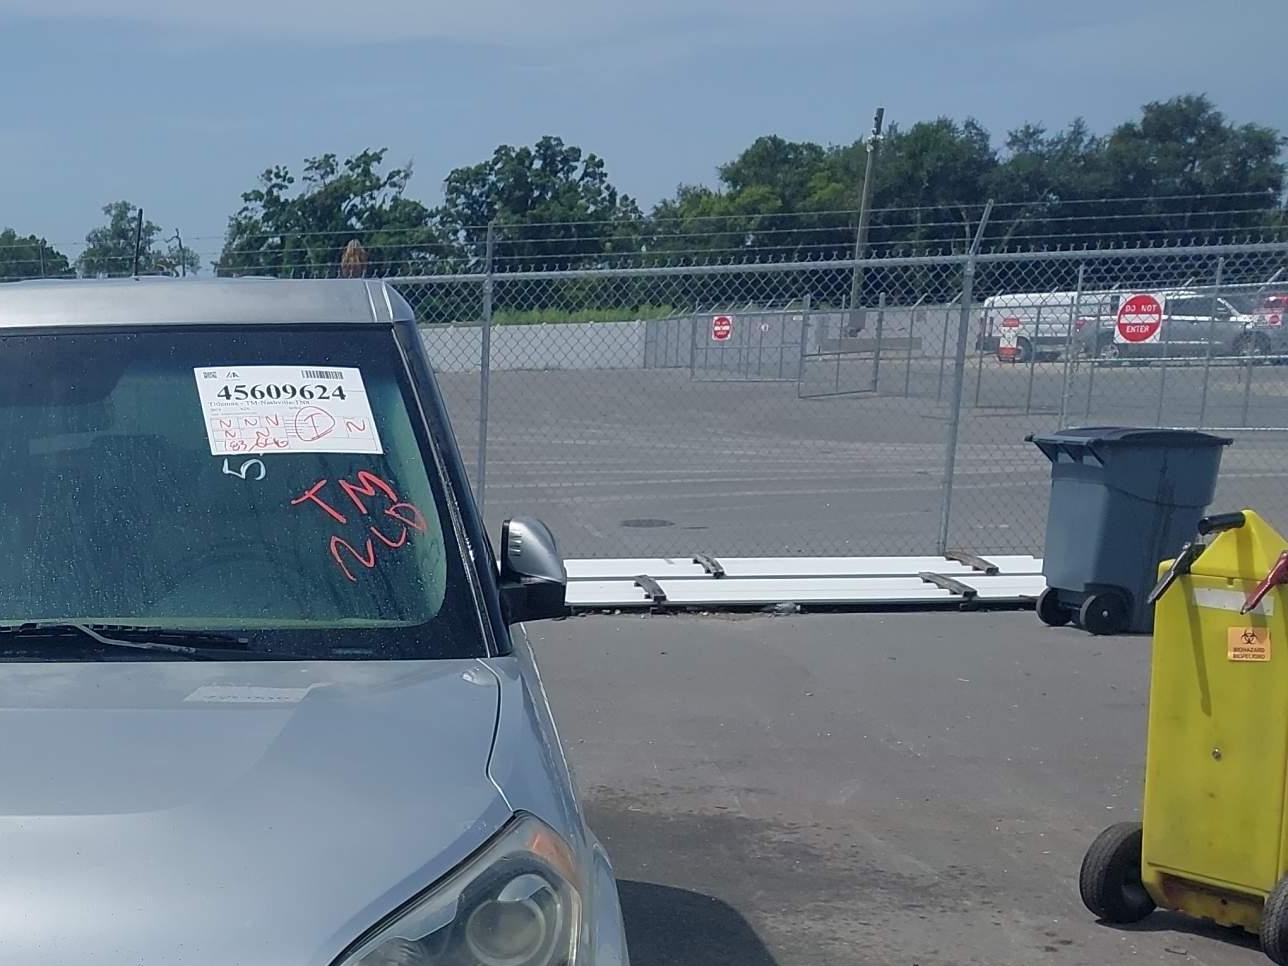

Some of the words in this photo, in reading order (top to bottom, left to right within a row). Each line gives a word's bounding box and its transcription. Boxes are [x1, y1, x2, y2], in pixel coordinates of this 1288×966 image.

[1141, 304, 1158, 312] NOT
[1126, 325, 1151, 333] ENTER
[217, 384, 347, 401] 45609624
[291, 471, 399, 524] TM
